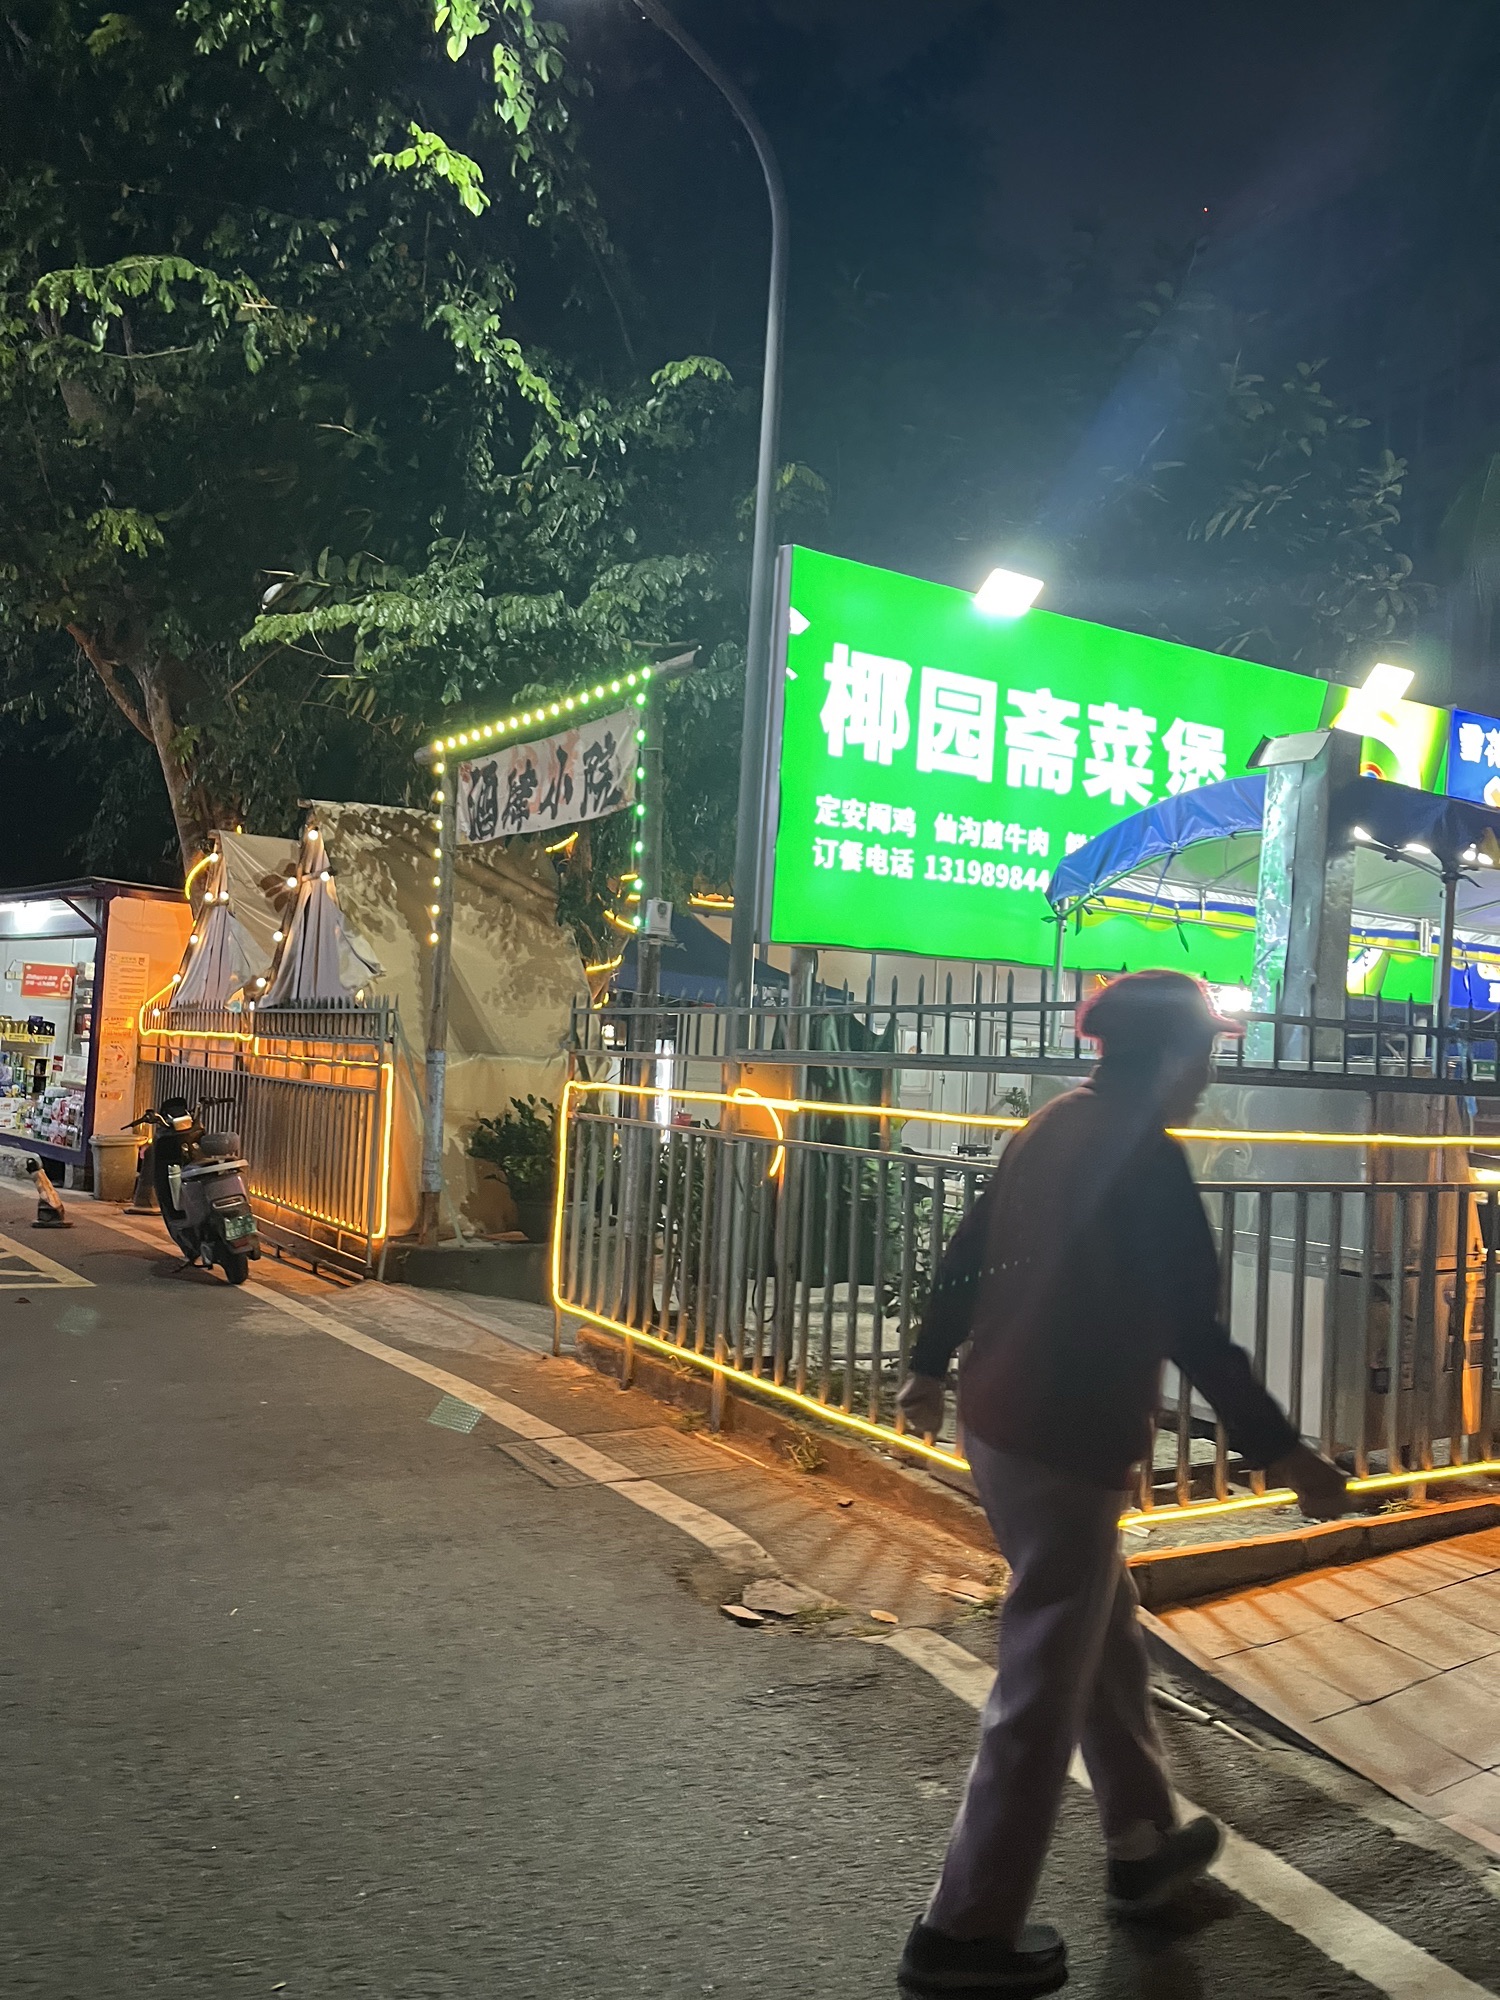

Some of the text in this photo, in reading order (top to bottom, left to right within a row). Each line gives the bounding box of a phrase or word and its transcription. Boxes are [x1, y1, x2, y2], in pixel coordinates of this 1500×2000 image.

[818, 642, 1228, 808] 椰园斋菜煲
[811, 836, 916, 880] 订餐电话
